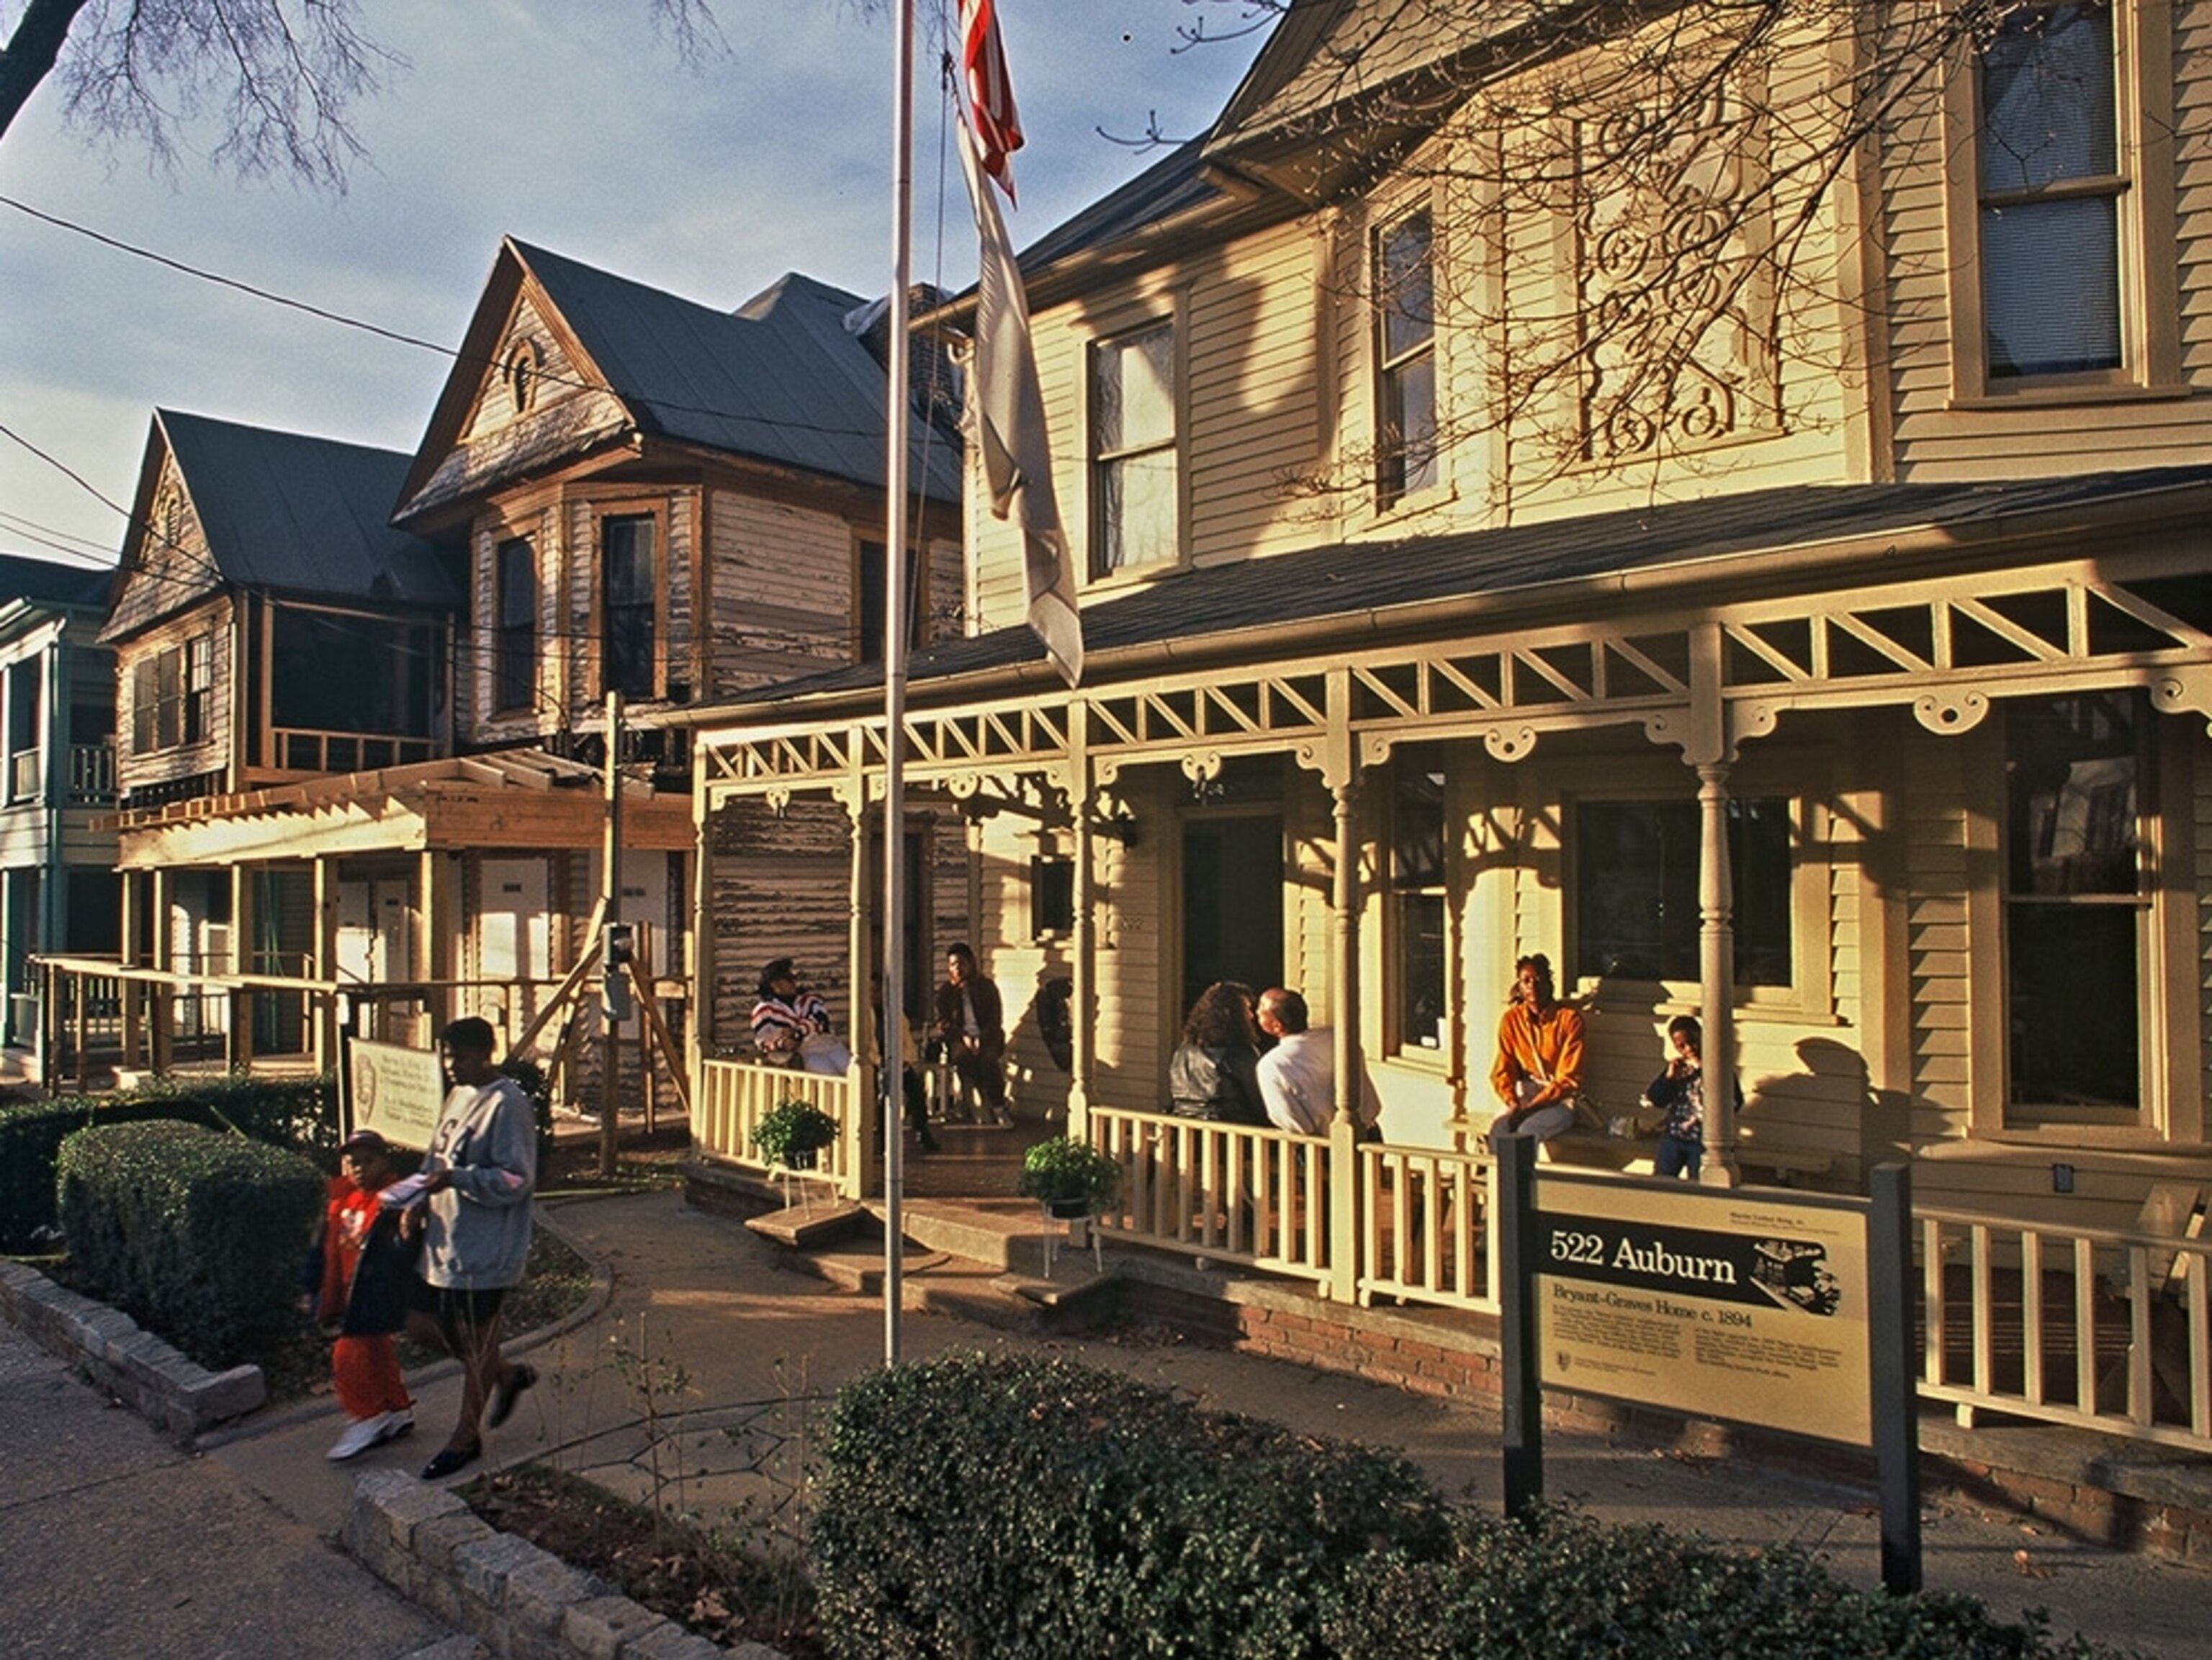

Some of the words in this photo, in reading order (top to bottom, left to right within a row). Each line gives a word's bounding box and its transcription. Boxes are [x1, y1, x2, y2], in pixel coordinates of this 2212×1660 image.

[1551, 1230, 1604, 1266] 522
[1611, 1237, 1737, 1285] Auburn
[1553, 1284, 1653, 1312] Bryant-Graves
[1656, 1299, 1697, 1321] Home
[1719, 1309, 1753, 1328] 1894
